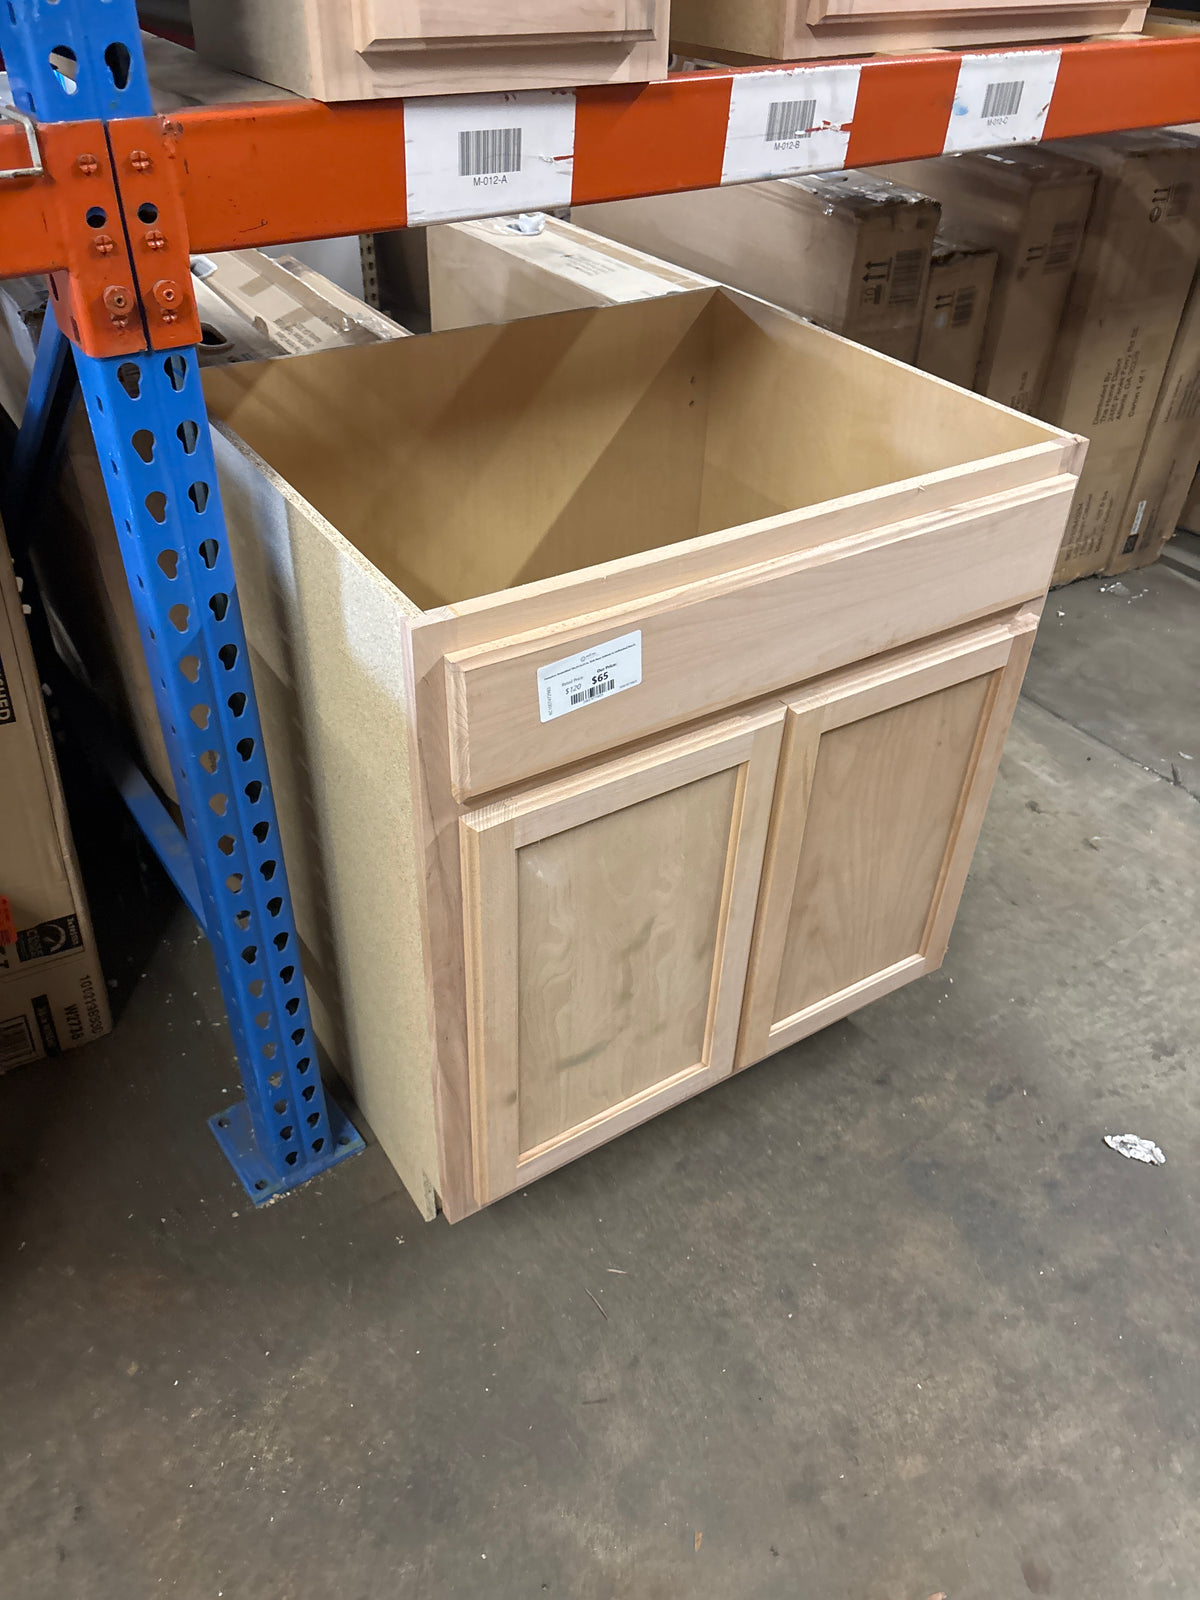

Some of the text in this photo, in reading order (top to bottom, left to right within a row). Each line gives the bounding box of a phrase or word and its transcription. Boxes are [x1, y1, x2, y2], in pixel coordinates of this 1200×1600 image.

[774, 140, 801, 151] M-012-B
[473, 174, 508, 186] M-012-A
[591, 671, 609, 685] $65
[565, 683, 582, 695] $120
